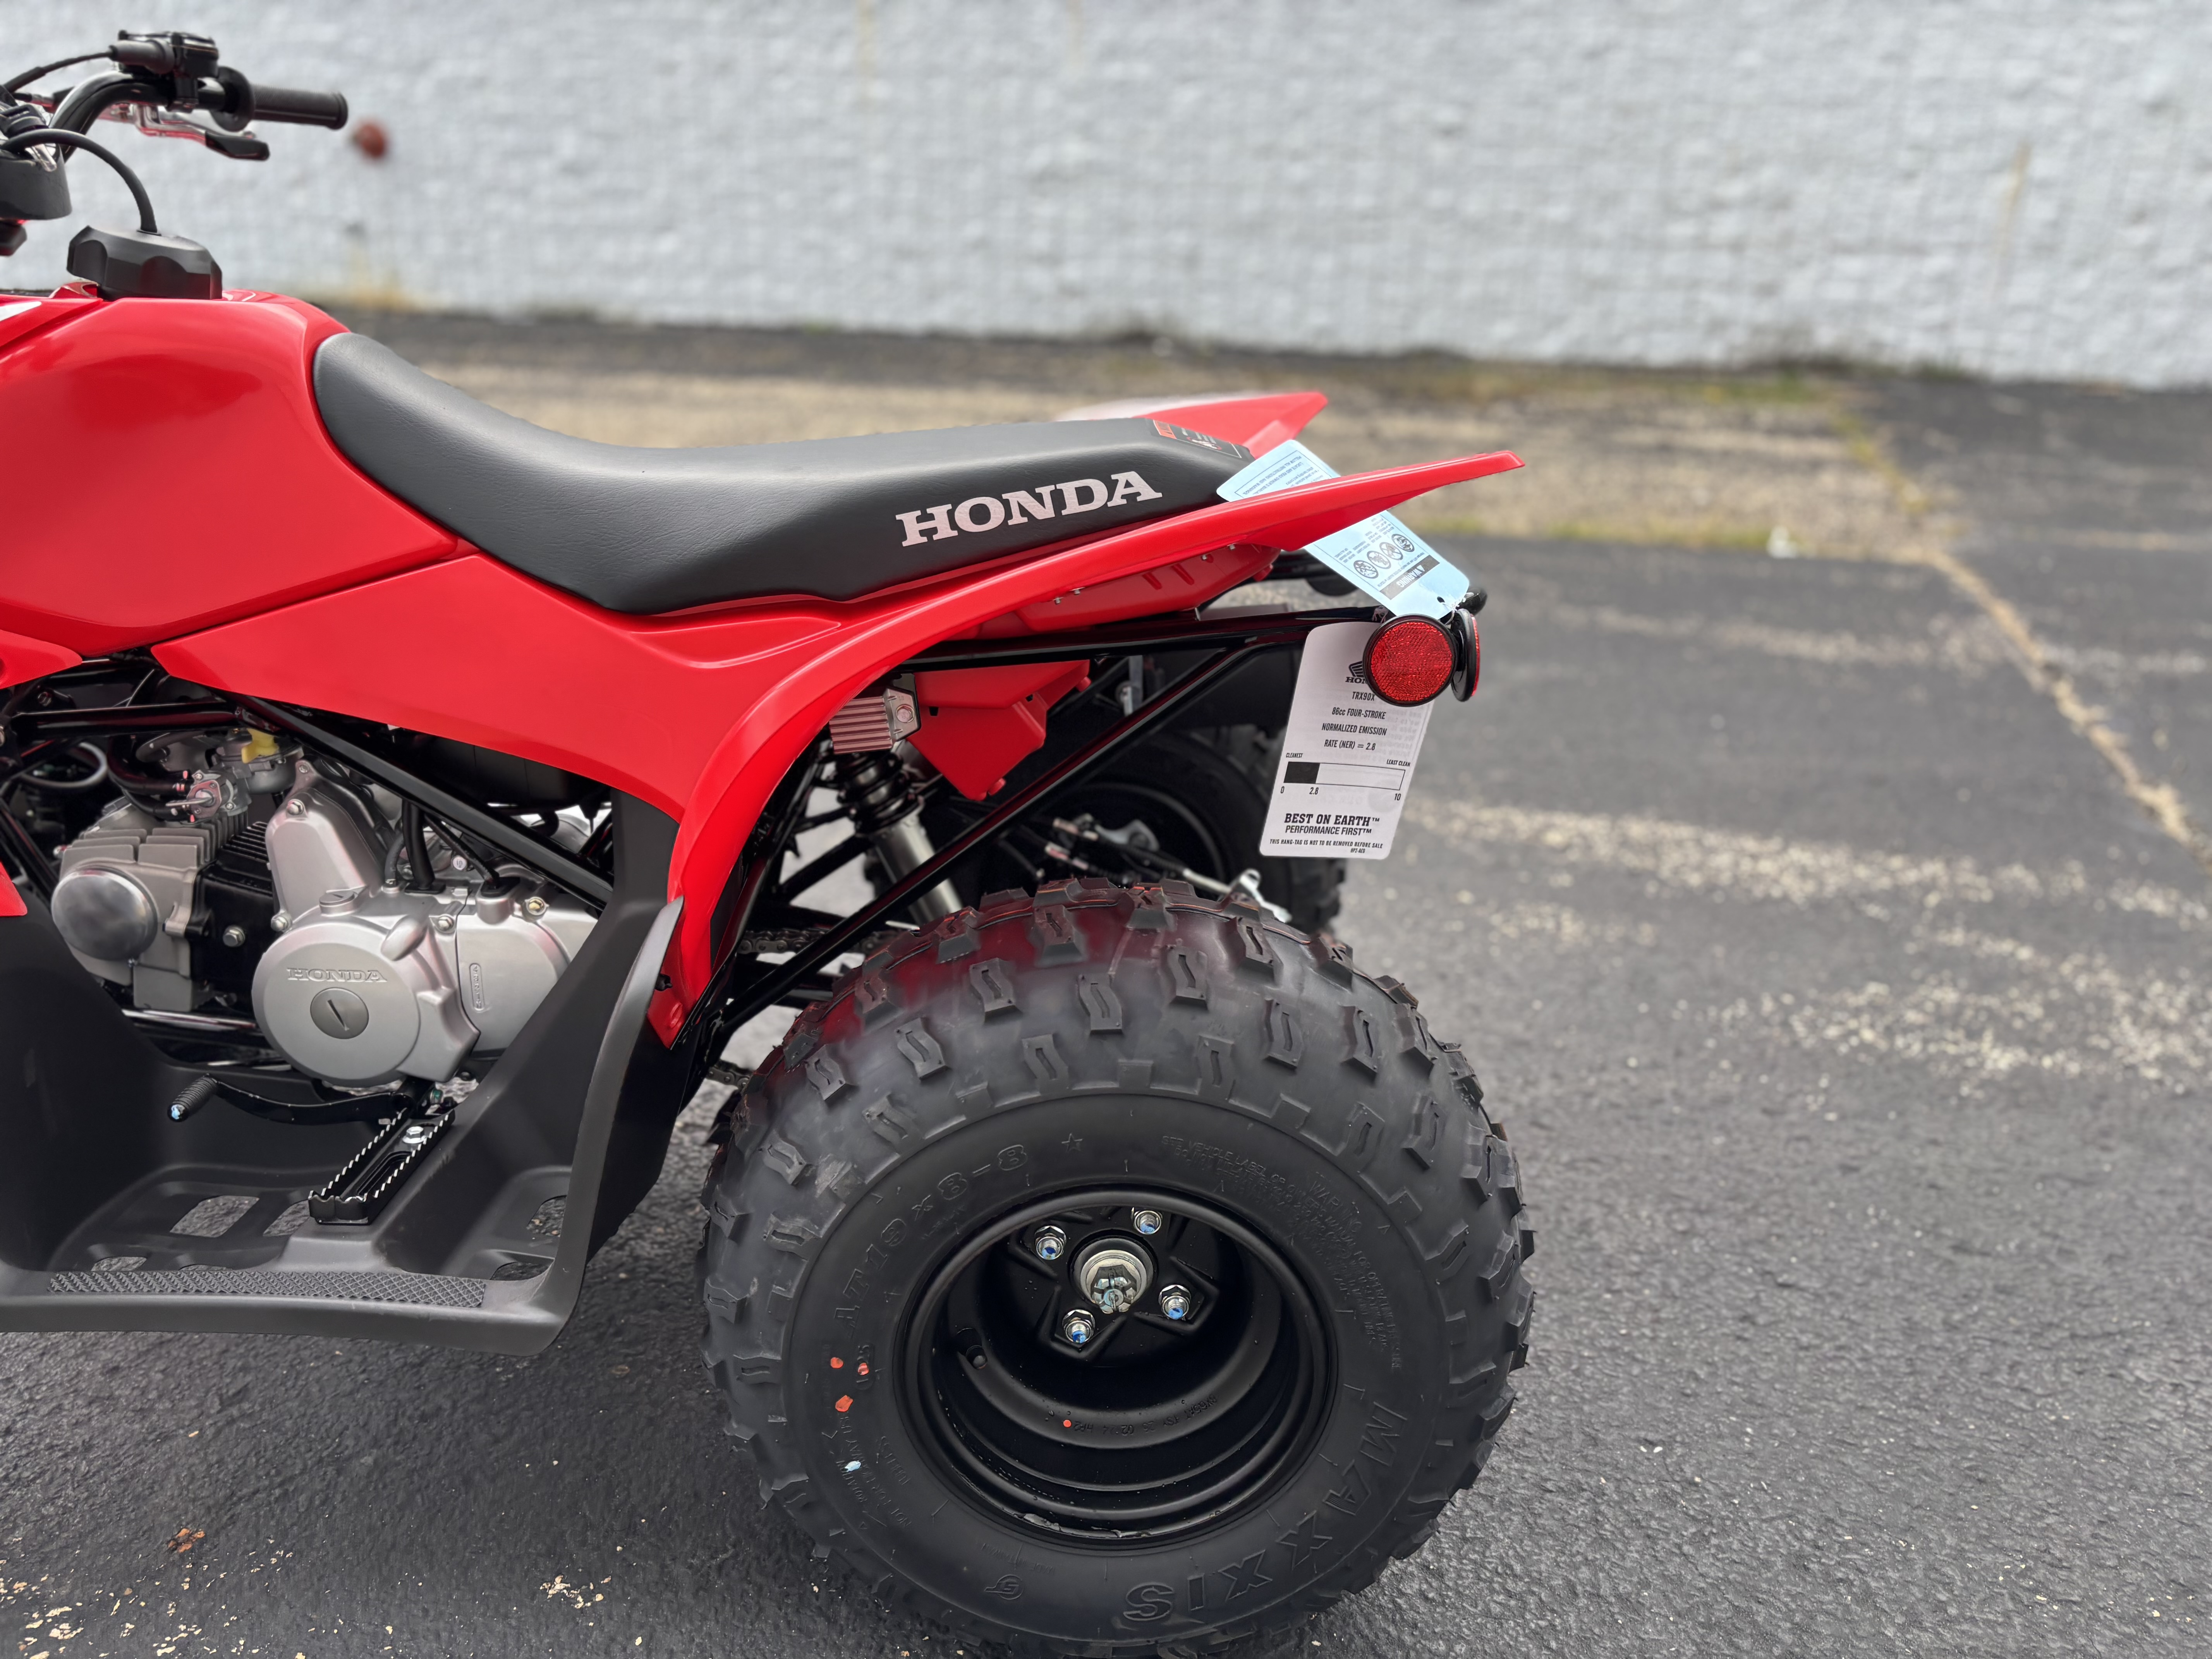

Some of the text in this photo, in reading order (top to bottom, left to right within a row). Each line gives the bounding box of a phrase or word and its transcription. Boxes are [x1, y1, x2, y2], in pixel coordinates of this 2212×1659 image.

[895, 471, 1163, 546] HONDA
[1396, 567, 1421, 587] WARNING
[1352, 691, 1376, 701] TRX90X
[1332, 707, 1386, 719] 86cc FOUR-STROKE
[1322, 723, 1387, 736] NORMALIZED EMISSION
[1324, 739, 1338, 747] RATE
[1339, 740, 1355, 749] (NER)
[1365, 742, 1376, 750] 2.8
[1284, 813, 1314, 823] BEST
[1316, 814, 1331, 824] ON
[1285, 825, 1340, 835] PERFORMANCE
[287, 967, 387, 982] HONDA
[1186, 1139, 1235, 1162] VEHICLE
[1233, 1154, 1271, 1178] LABEL
[1123, 1401, 1408, 1621] MAXXIS
